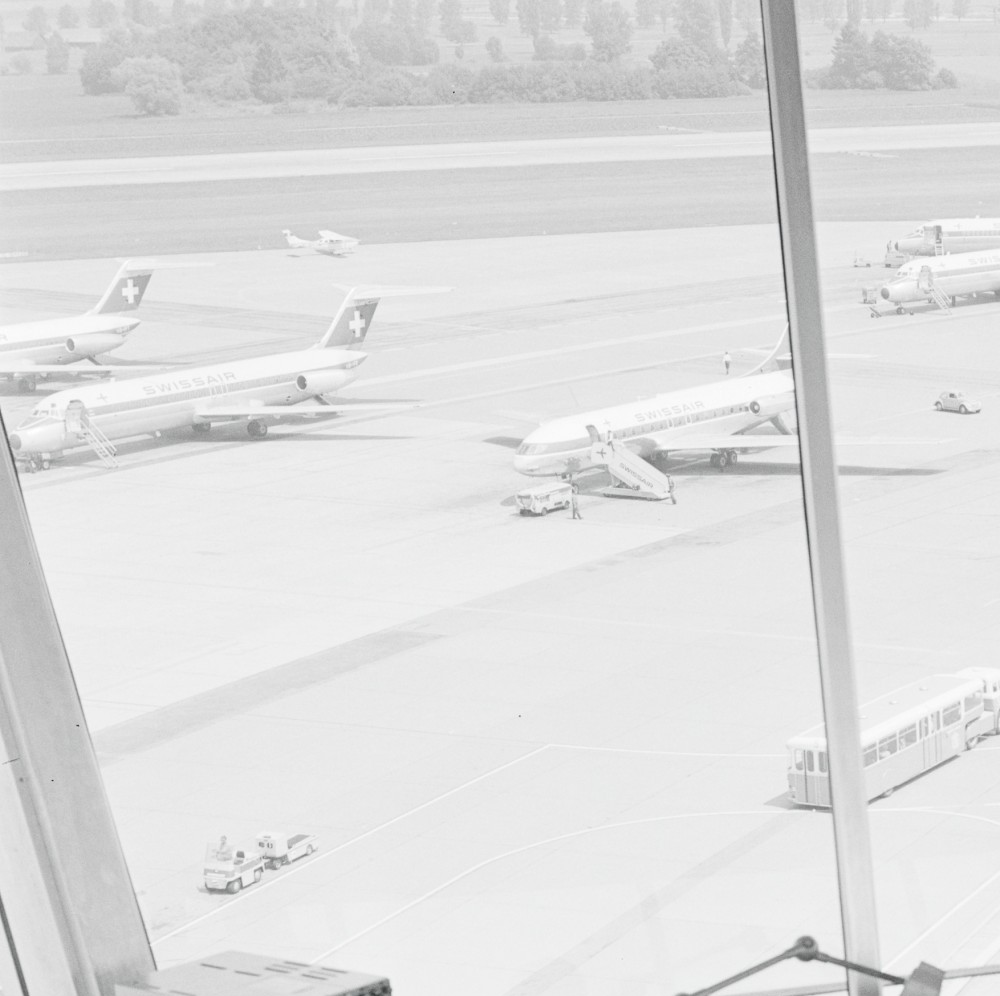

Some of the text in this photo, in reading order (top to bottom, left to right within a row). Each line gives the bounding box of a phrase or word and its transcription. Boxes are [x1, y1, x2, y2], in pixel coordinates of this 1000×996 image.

[142, 372, 236, 395] SWISSAIR
[634, 401, 705, 422] SWISSAIR
[619, 462, 654, 488] SWISSAIR
